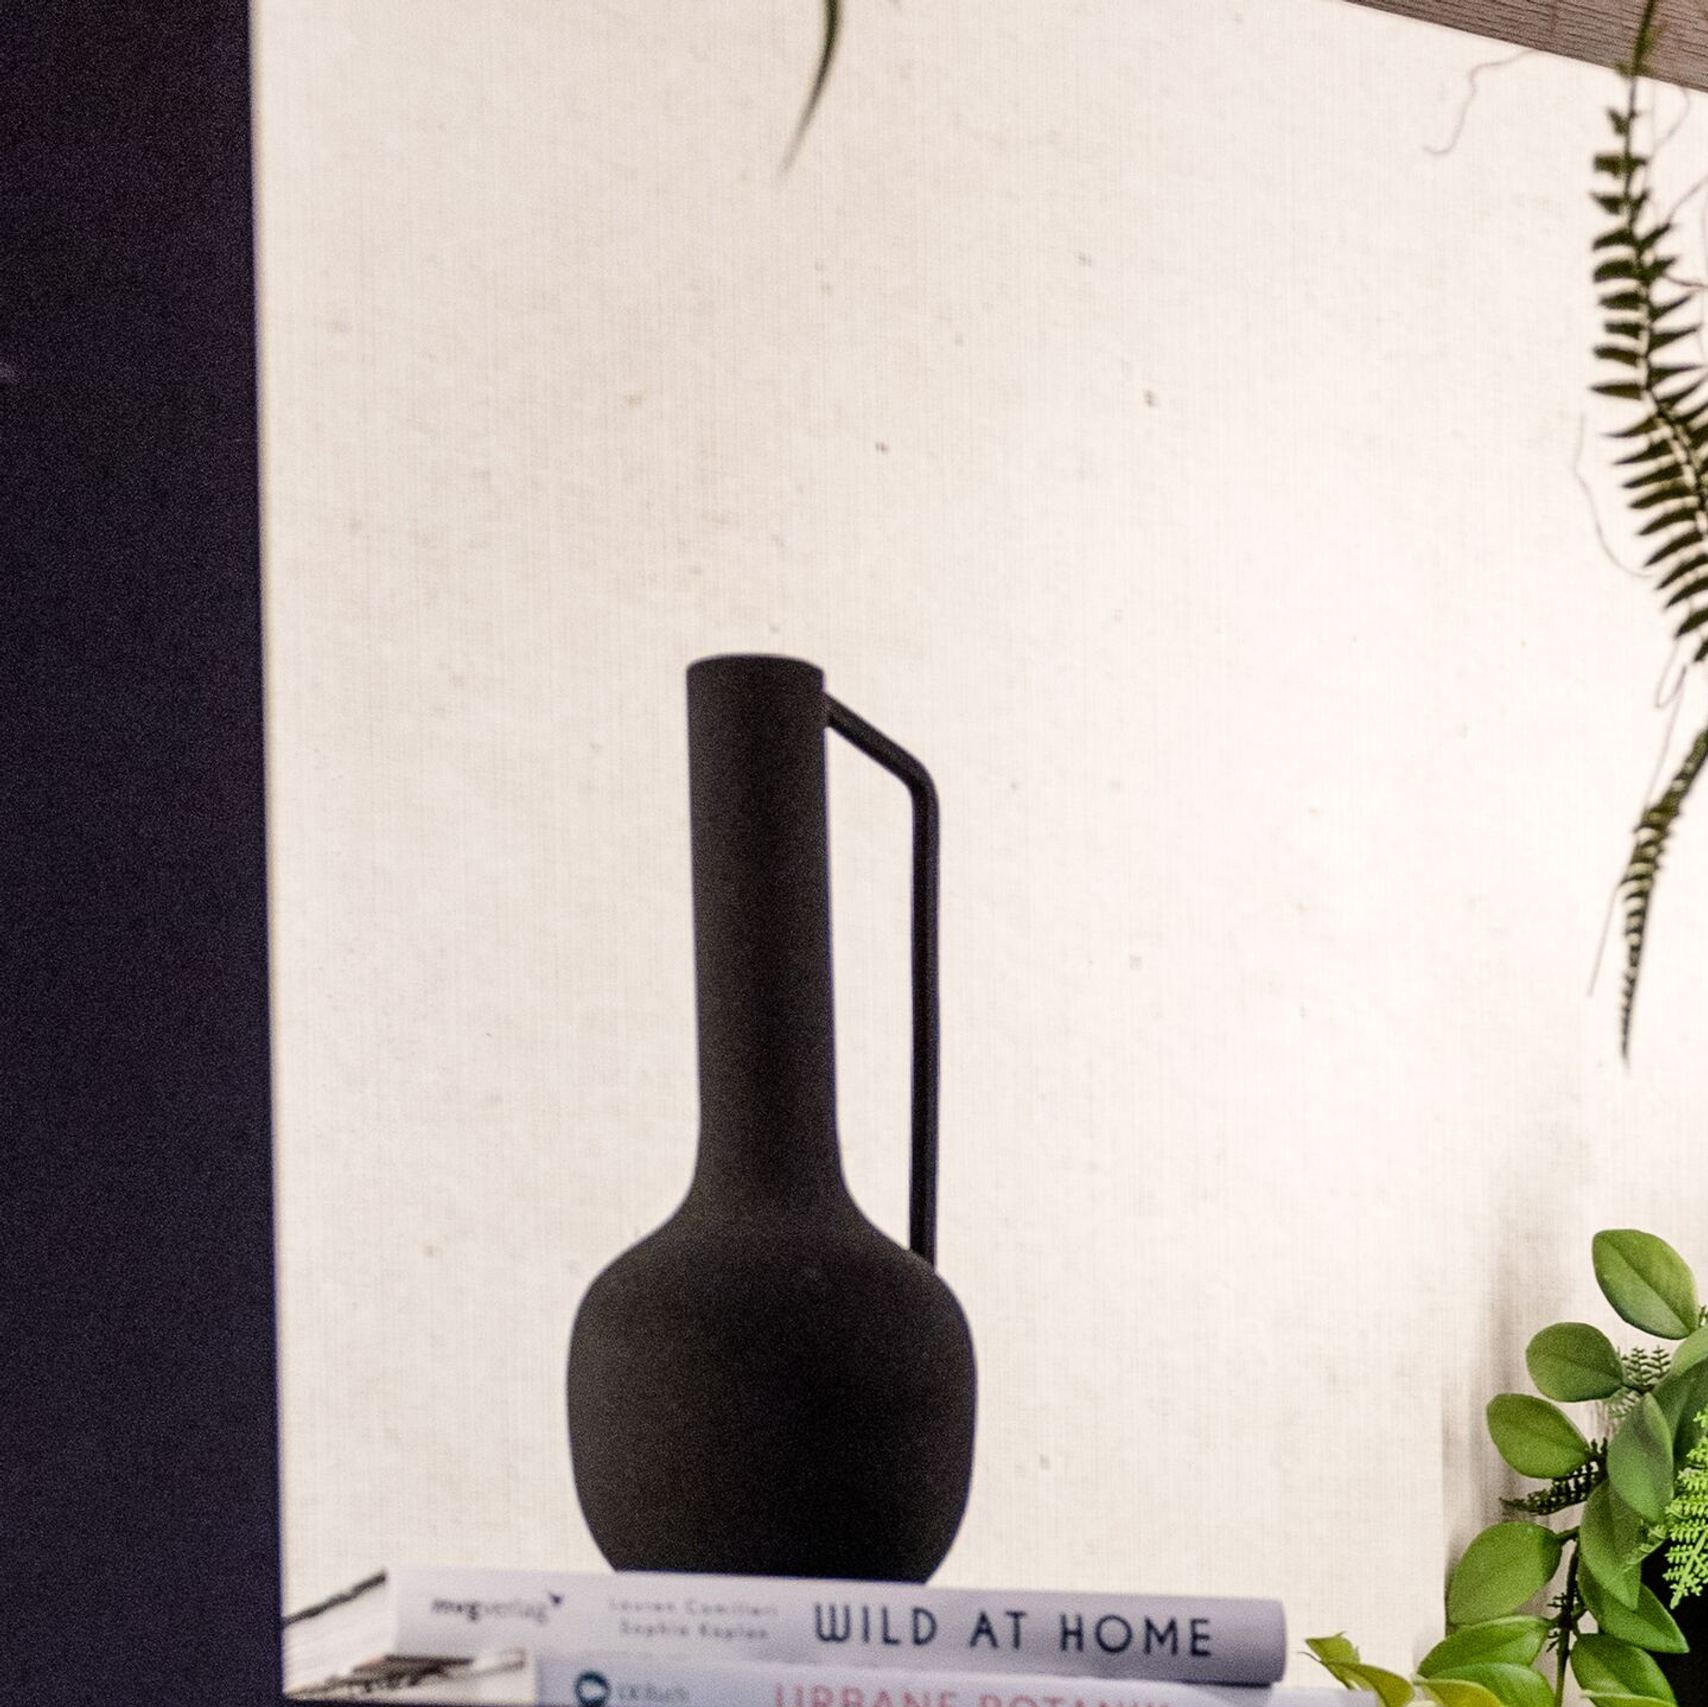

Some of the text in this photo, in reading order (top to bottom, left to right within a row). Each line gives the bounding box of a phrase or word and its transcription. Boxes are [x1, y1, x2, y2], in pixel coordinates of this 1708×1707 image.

[815, 1604, 1213, 1658] WILD AT HOME
